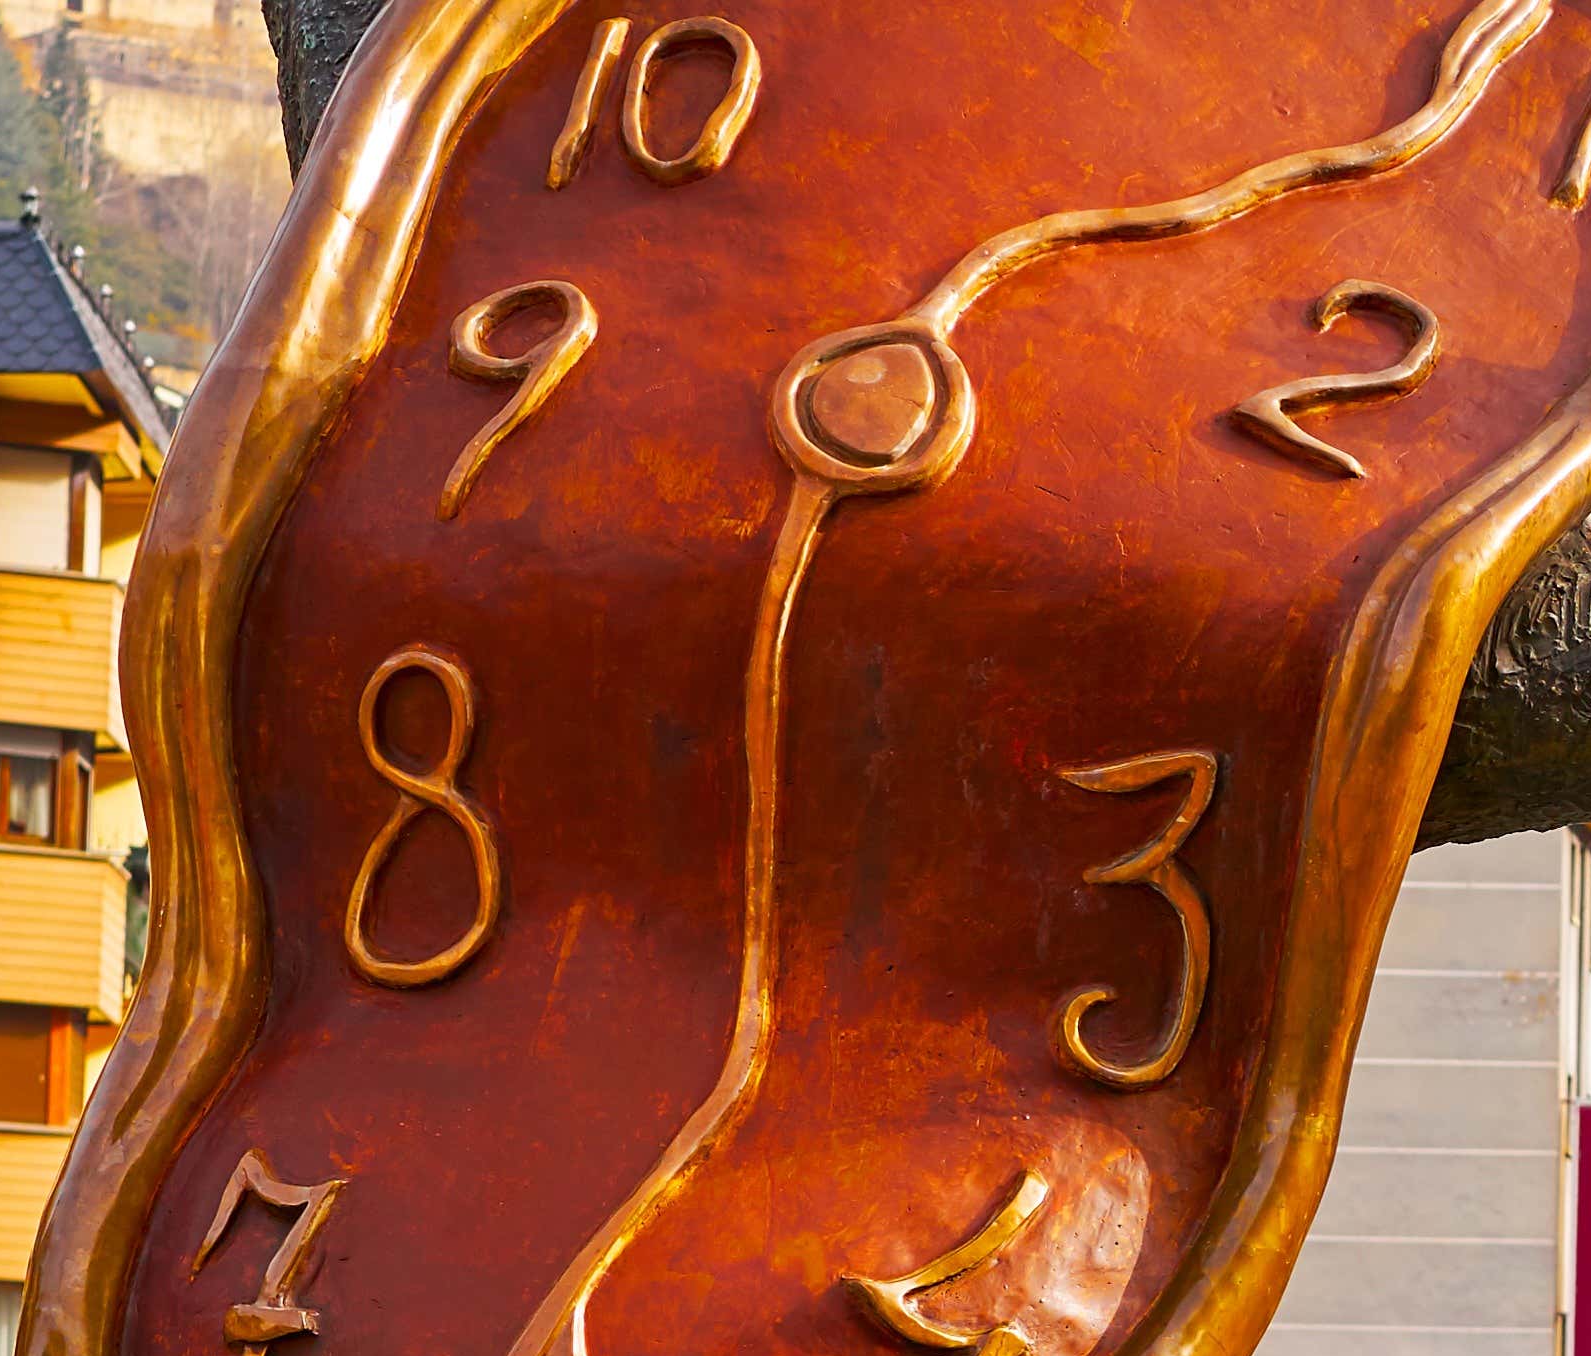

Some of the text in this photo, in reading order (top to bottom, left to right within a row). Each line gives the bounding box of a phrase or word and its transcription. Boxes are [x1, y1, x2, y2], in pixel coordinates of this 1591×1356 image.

[546, 15, 762, 188] 10
[442, 278, 598, 520] 9
[1232, 278, 1443, 480] 2
[344, 644, 504, 988] 8
[1058, 750, 1218, 1090] 3
